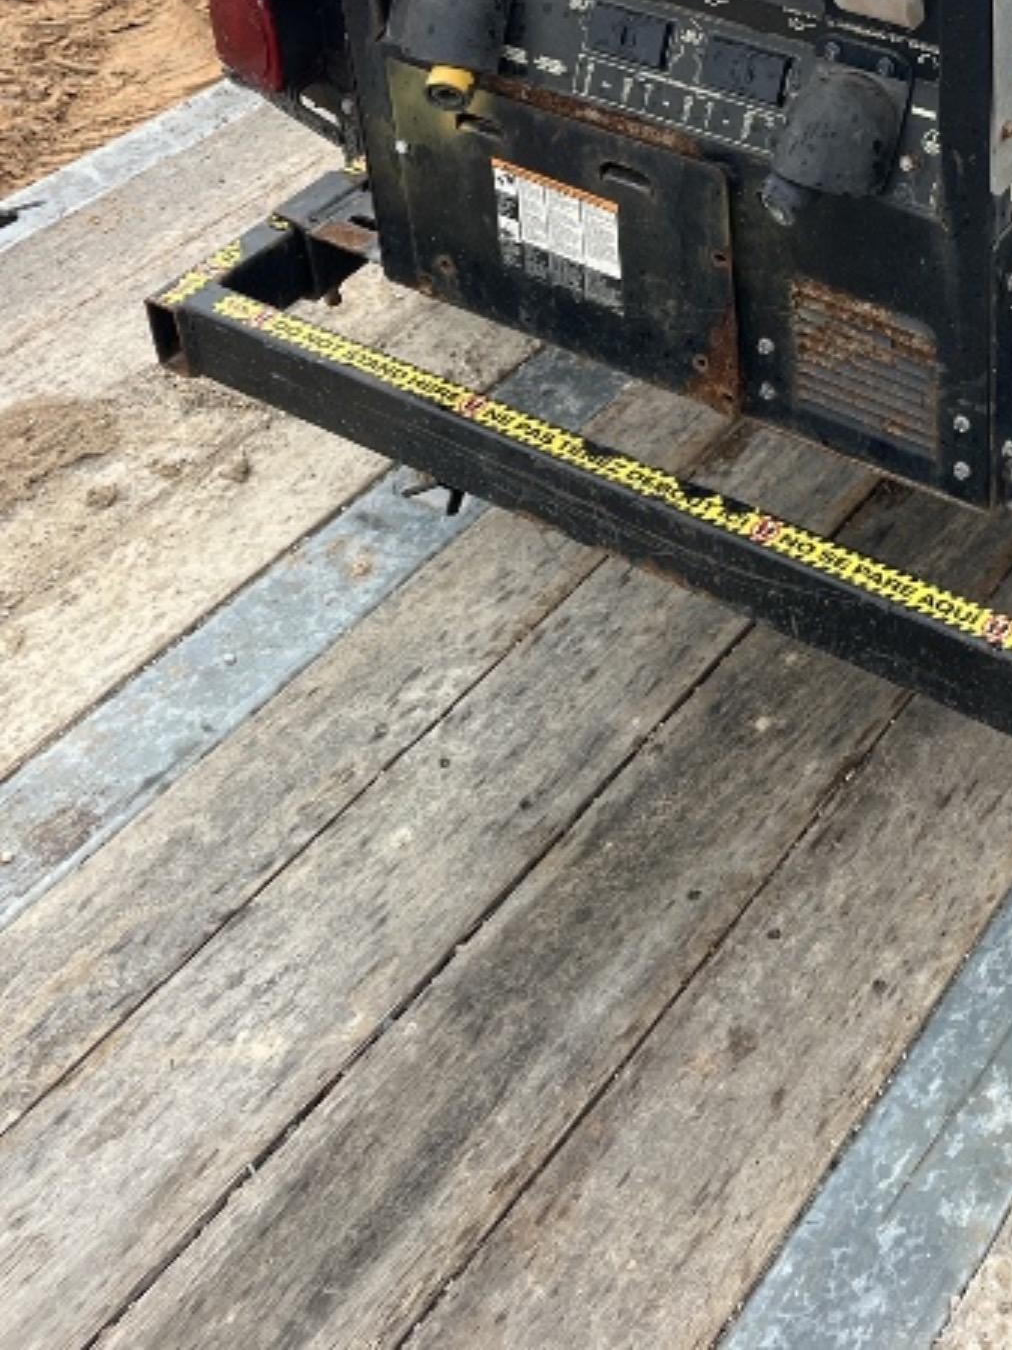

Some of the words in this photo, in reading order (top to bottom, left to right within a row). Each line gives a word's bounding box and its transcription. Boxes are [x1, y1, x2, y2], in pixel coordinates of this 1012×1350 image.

[272, 319, 305, 338] DO
[304, 330, 345, 355] NOT
[342, 348, 410, 381] STAND
[407, 373, 461, 403] HERE
[482, 407, 515, 427] NE
[513, 421, 557, 446] PAS
[778, 533, 817, 552] NO
[818, 549, 853, 571] SE
[853, 562, 920, 598] PARE
